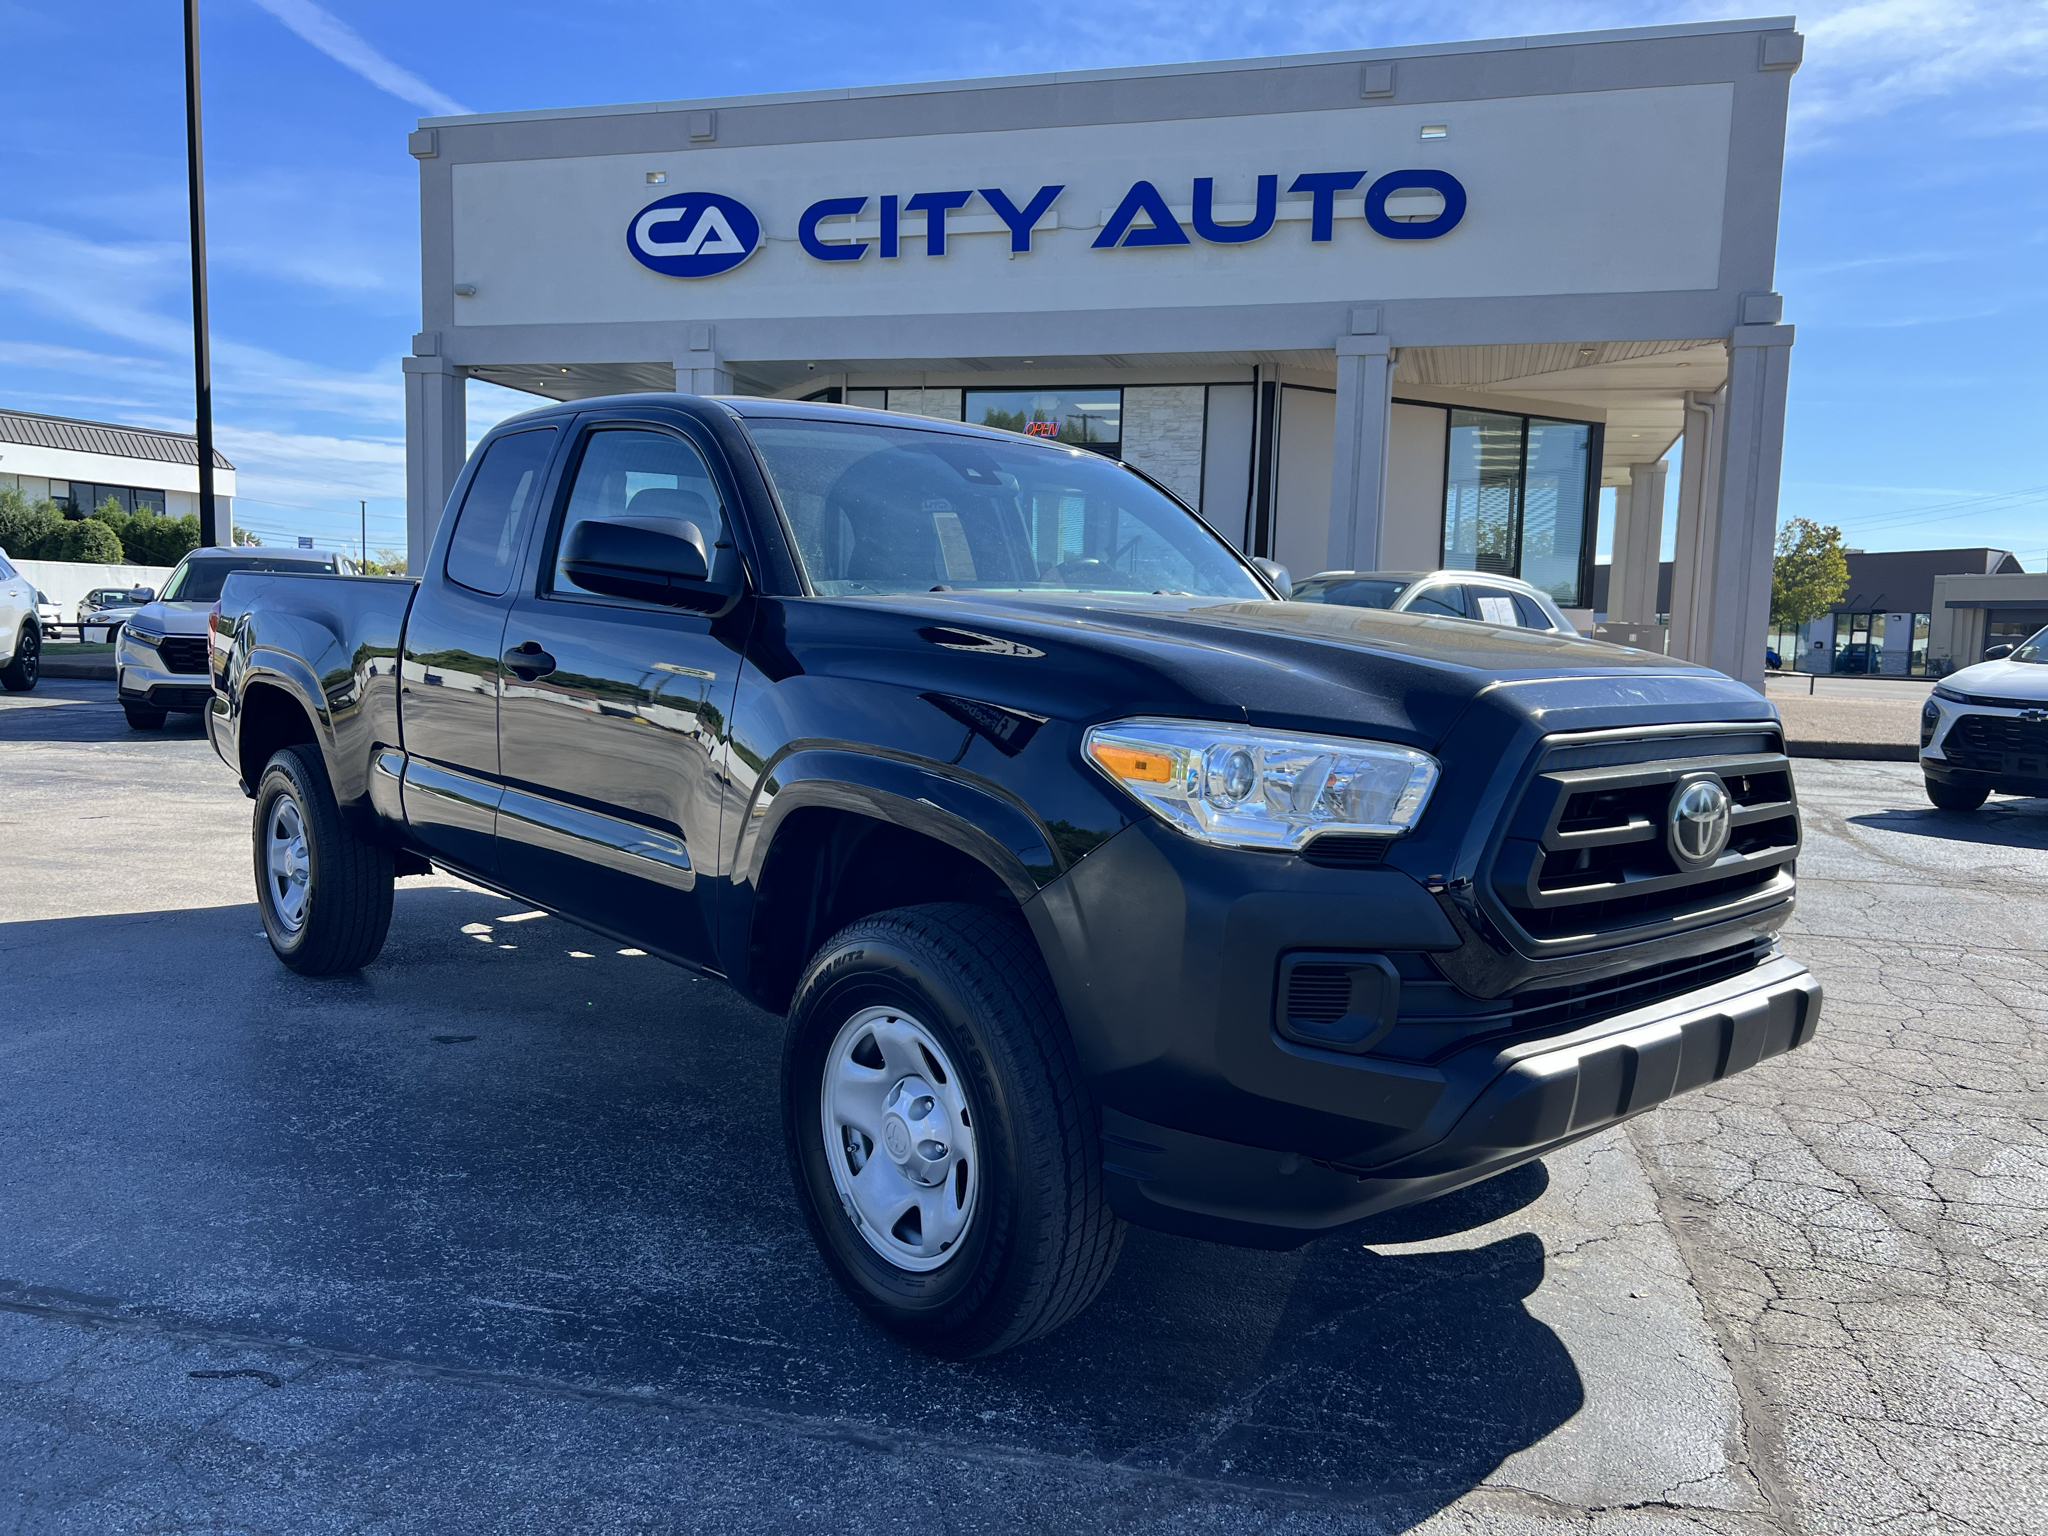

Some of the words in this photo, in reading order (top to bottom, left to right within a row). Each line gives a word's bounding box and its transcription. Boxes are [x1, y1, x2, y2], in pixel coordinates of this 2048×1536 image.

[635, 206, 746, 257] CA
[797, 185, 1065, 261] CITY
[1091, 169, 1467, 248] AUTO
[1026, 422, 1059, 436] OPEN
